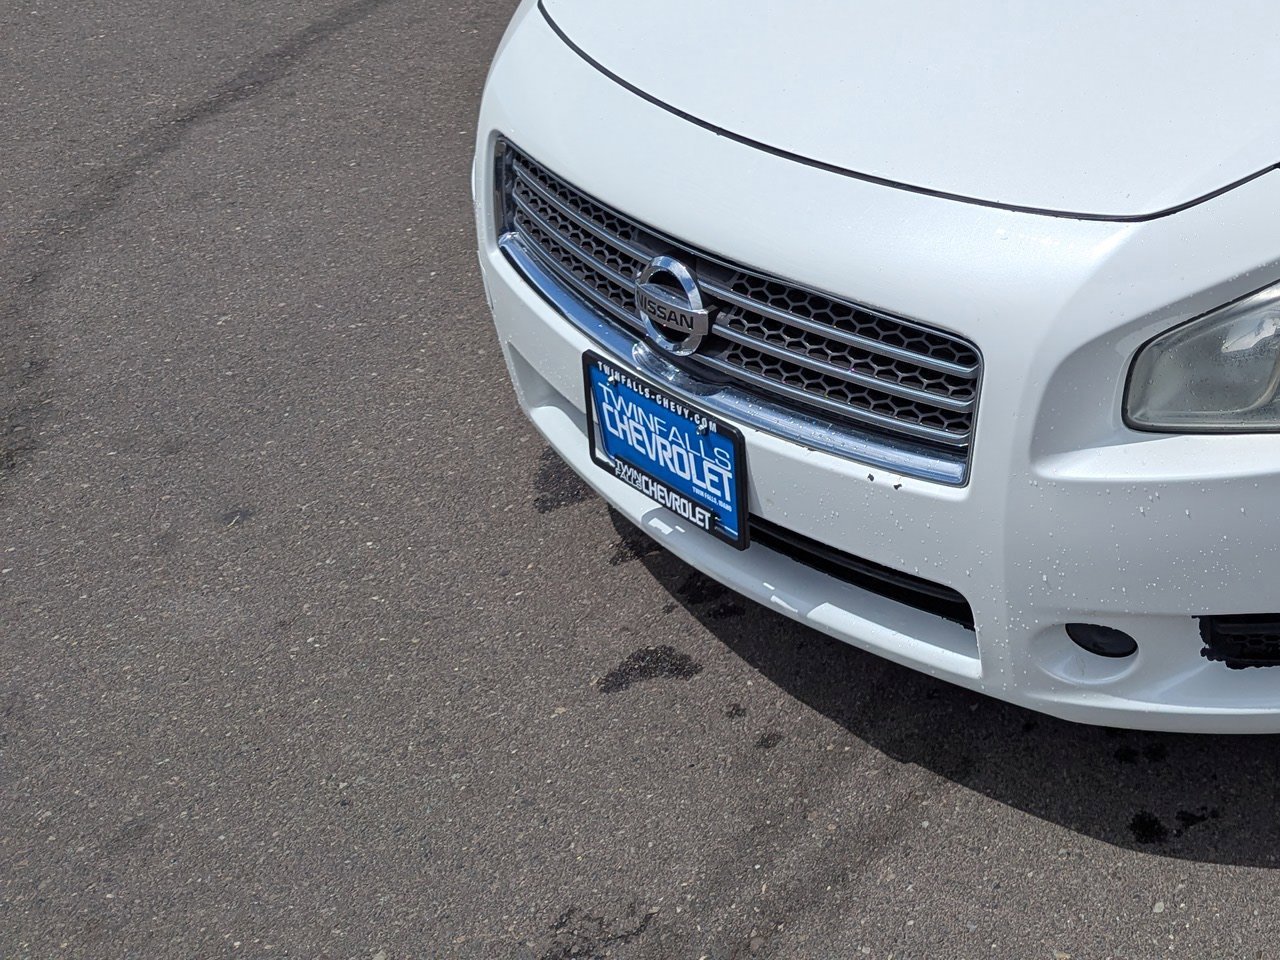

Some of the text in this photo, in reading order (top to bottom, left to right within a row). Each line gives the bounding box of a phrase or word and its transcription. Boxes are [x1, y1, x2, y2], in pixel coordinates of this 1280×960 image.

[636, 290, 693, 330] NISSAN
[602, 402, 733, 502] CHEVROLET
[641, 474, 711, 530] CHEVROLET
